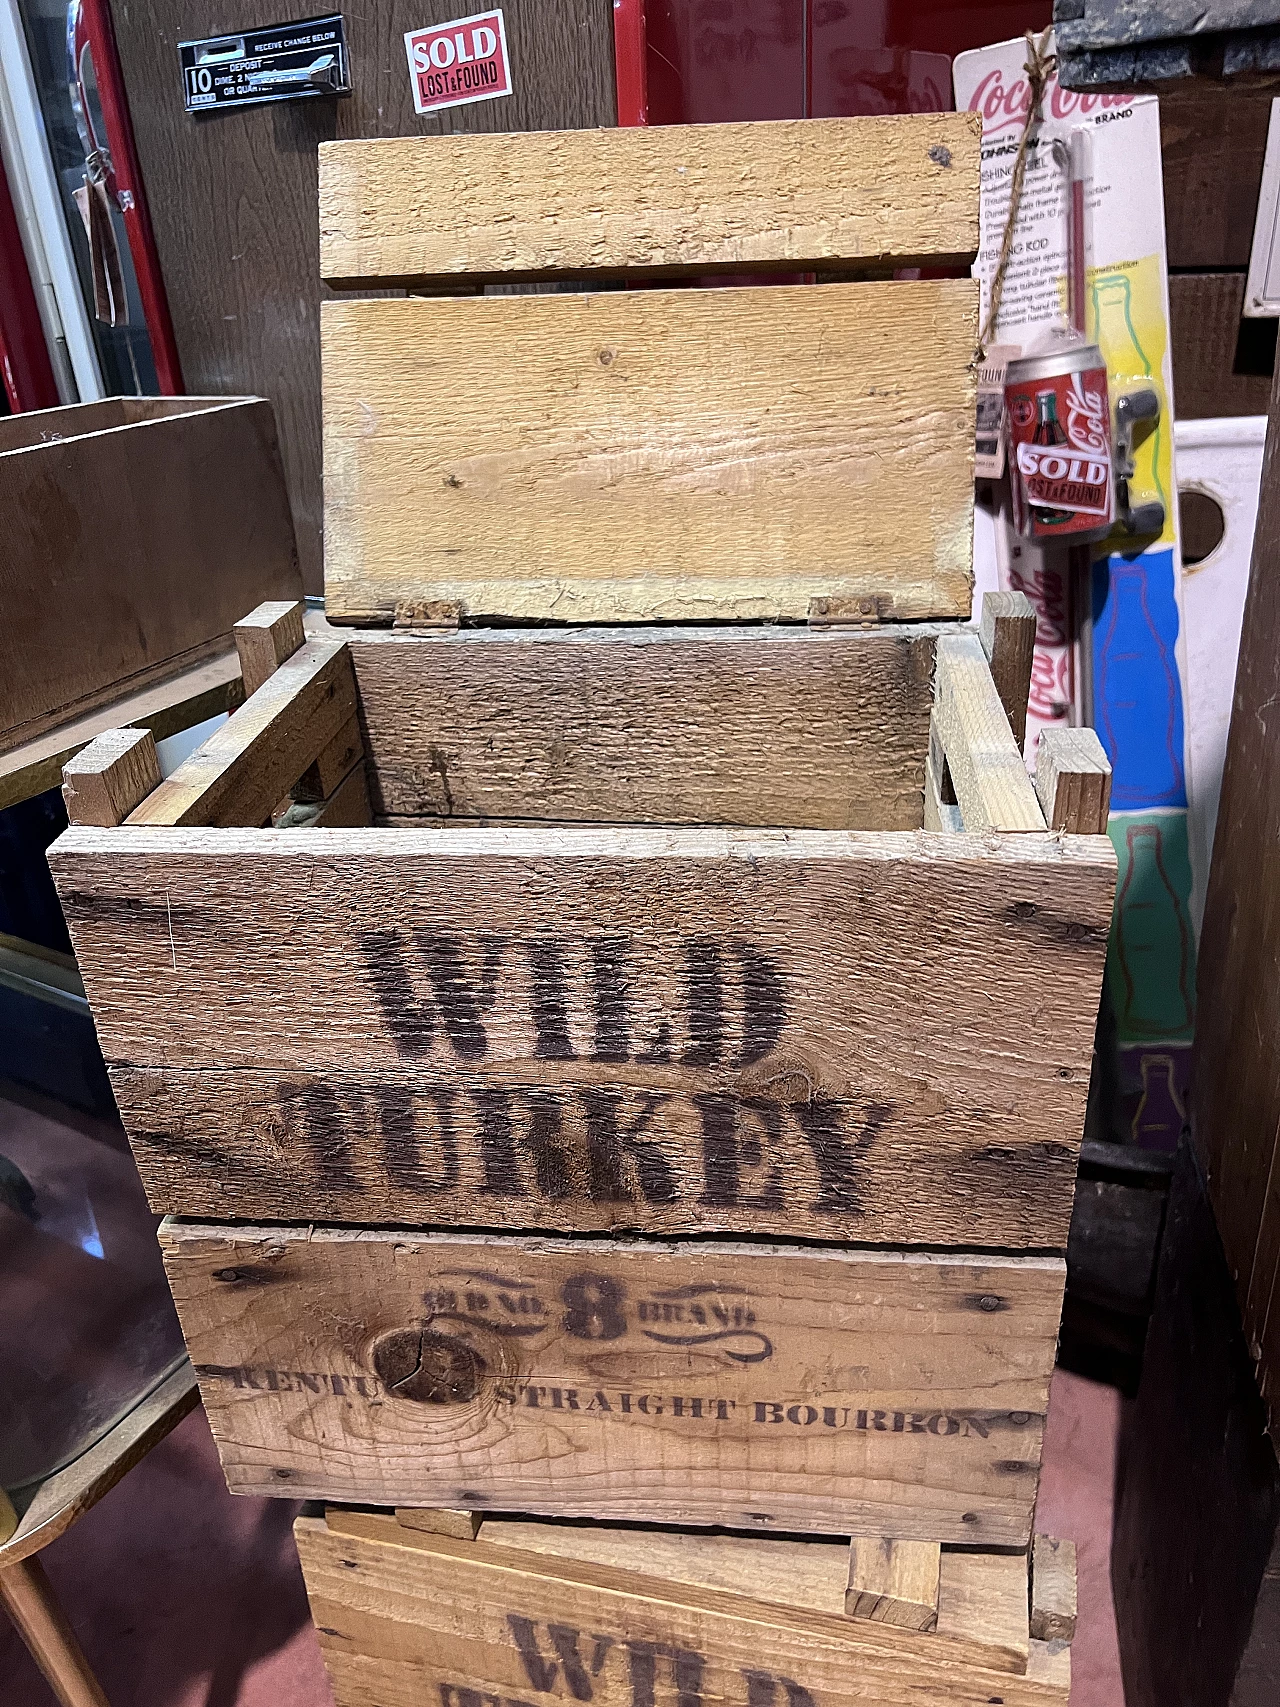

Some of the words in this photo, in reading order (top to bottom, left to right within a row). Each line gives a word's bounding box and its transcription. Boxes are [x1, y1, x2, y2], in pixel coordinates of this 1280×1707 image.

[254, 40, 282, 52] RECEIVE
[283, 35, 311, 47] CHANGE
[311, 31, 336, 43] BELOW
[413, 26, 497, 74] SOLD
[229, 59, 263, 73] DEPOSIT
[236, 74, 243, 83] 2
[190, 68, 212, 94] 10
[223, 87, 235, 96] OR
[1094, 108, 1133, 125] BRAND
[1025, 237, 1049, 251] ROD
[1066, 389, 1106, 454] Cola
[1020, 453, 1107, 485] SOLD
[354, 927, 791, 1068] WILD
[280, 1080, 893, 1217] TURKEY
[560, 1271, 628, 1341] 8
[636, 1303, 757, 1327] BRAND
[493, 1381, 736, 1422] STRAIGHT
[751, 1402, 991, 1441] BOURBON
